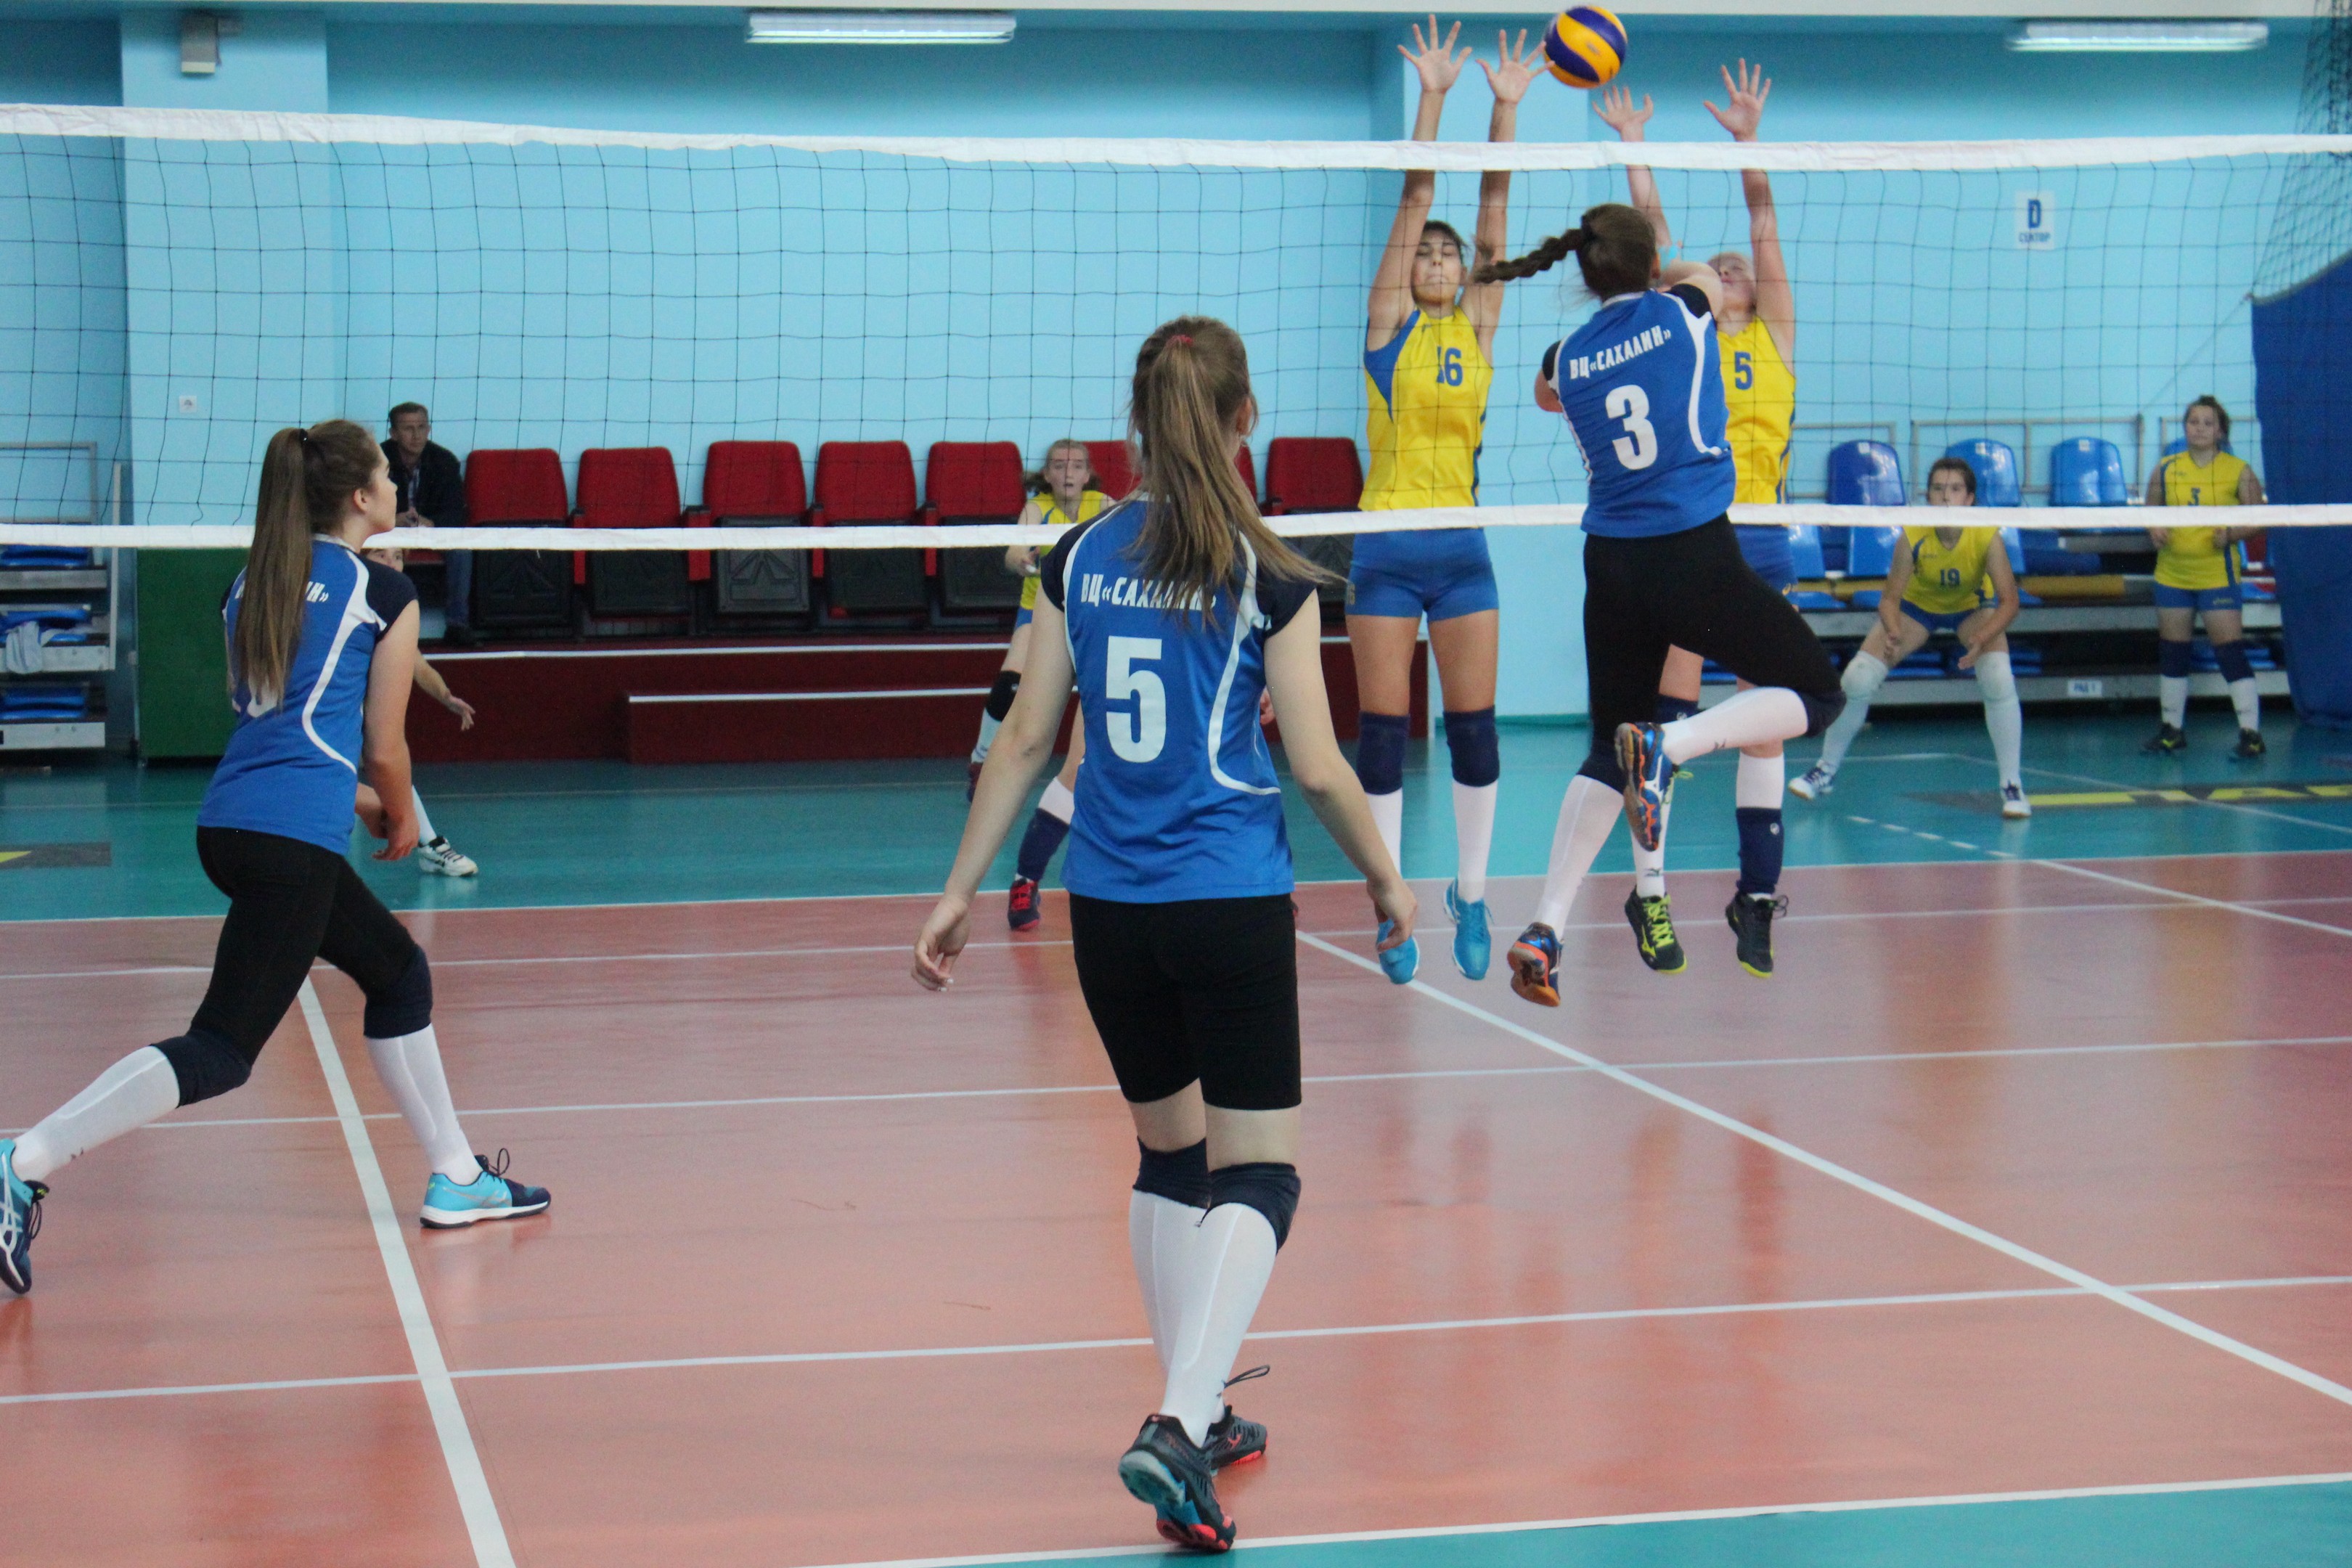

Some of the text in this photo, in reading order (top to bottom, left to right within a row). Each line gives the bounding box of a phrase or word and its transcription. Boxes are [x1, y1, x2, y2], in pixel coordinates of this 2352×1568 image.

[2028, 199, 2041, 229] D
[1734, 351, 1753, 390] 5
[1605, 384, 1658, 470] 3
[1940, 568, 1961, 588] 19
[1106, 635, 1167, 763] 5
